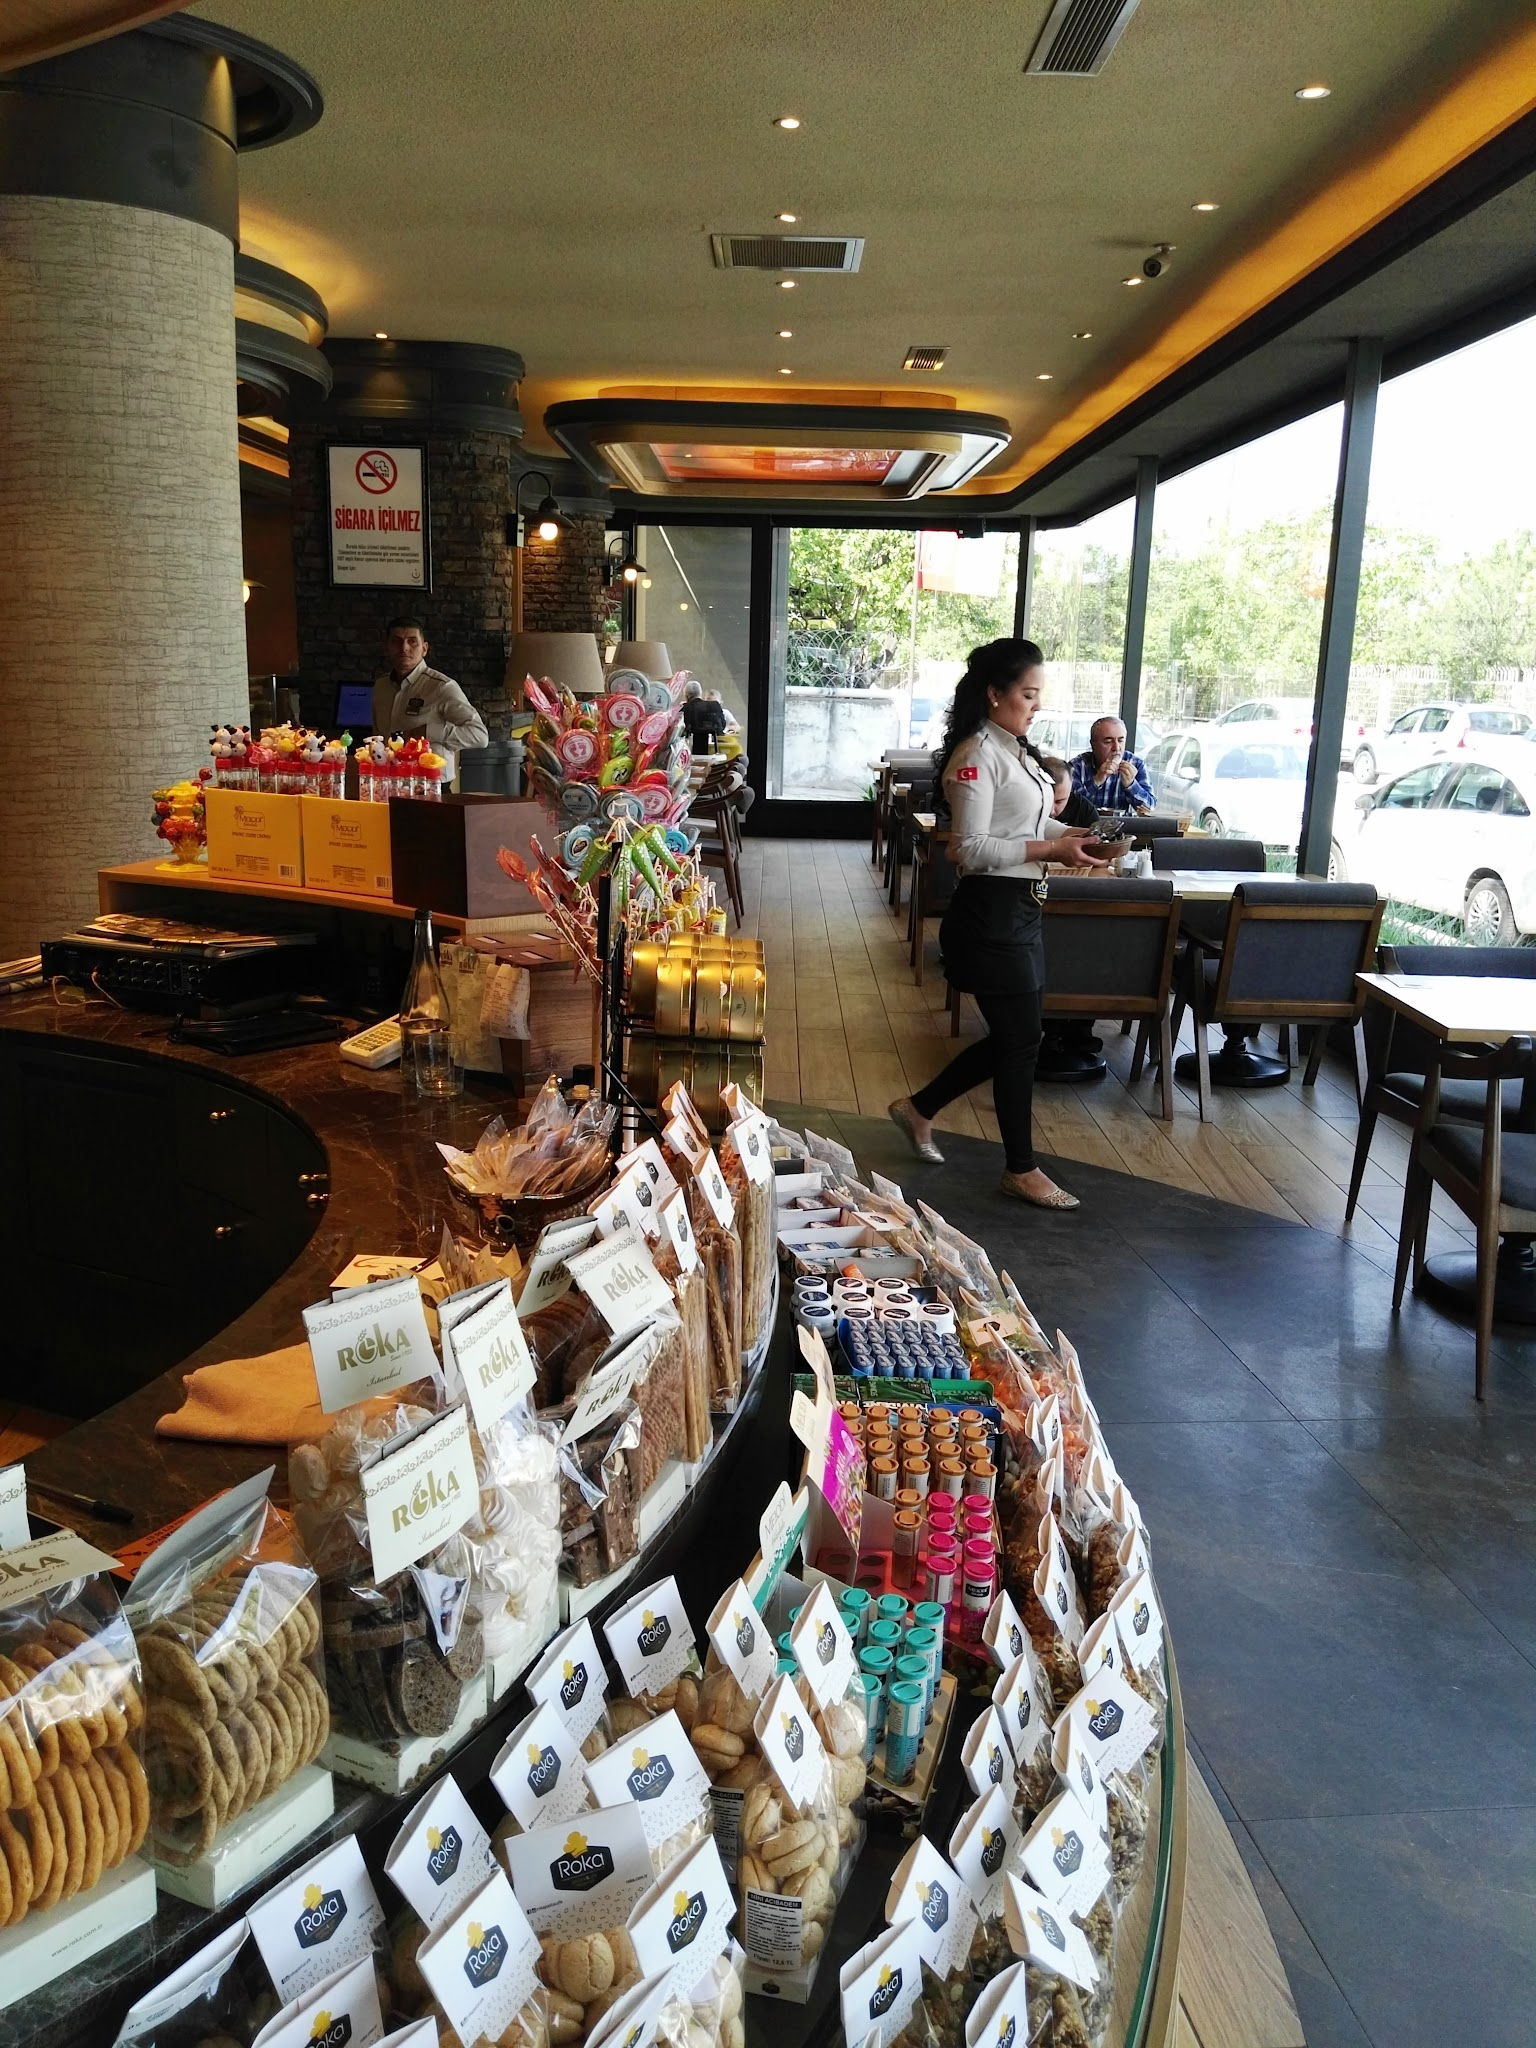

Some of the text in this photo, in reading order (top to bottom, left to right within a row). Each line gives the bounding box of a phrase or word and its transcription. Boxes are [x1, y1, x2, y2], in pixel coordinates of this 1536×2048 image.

[335, 505, 421, 534] SİGARA İÇİLMEZ
[602, 1261, 648, 1302] ROKA
[337, 1321, 412, 1371] ROKA
[478, 1335, 520, 1388] ROKA
[391, 1470, 460, 1533] ROKA
[641, 1619, 667, 1648] Roka
[817, 1626, 835, 1657] Roka
[561, 1668, 585, 1701] Roka
[1092, 1703, 1117, 1733] Roka
[785, 1720, 801, 1753] Roka
[530, 1752, 556, 1786] Roka
[631, 1760, 667, 1792] Roka
[430, 1833, 457, 1874] Roka
[558, 1853, 605, 1879] Roka
[983, 1834, 1002, 1867] Roka
[1056, 1836, 1078, 1868] Roka
[301, 1897, 340, 1936] Roka
[671, 1900, 702, 1942] Roka
[924, 1886, 943, 1924] Roka
[467, 1932, 502, 1975] Roka
[873, 1975, 900, 2009] Roka
